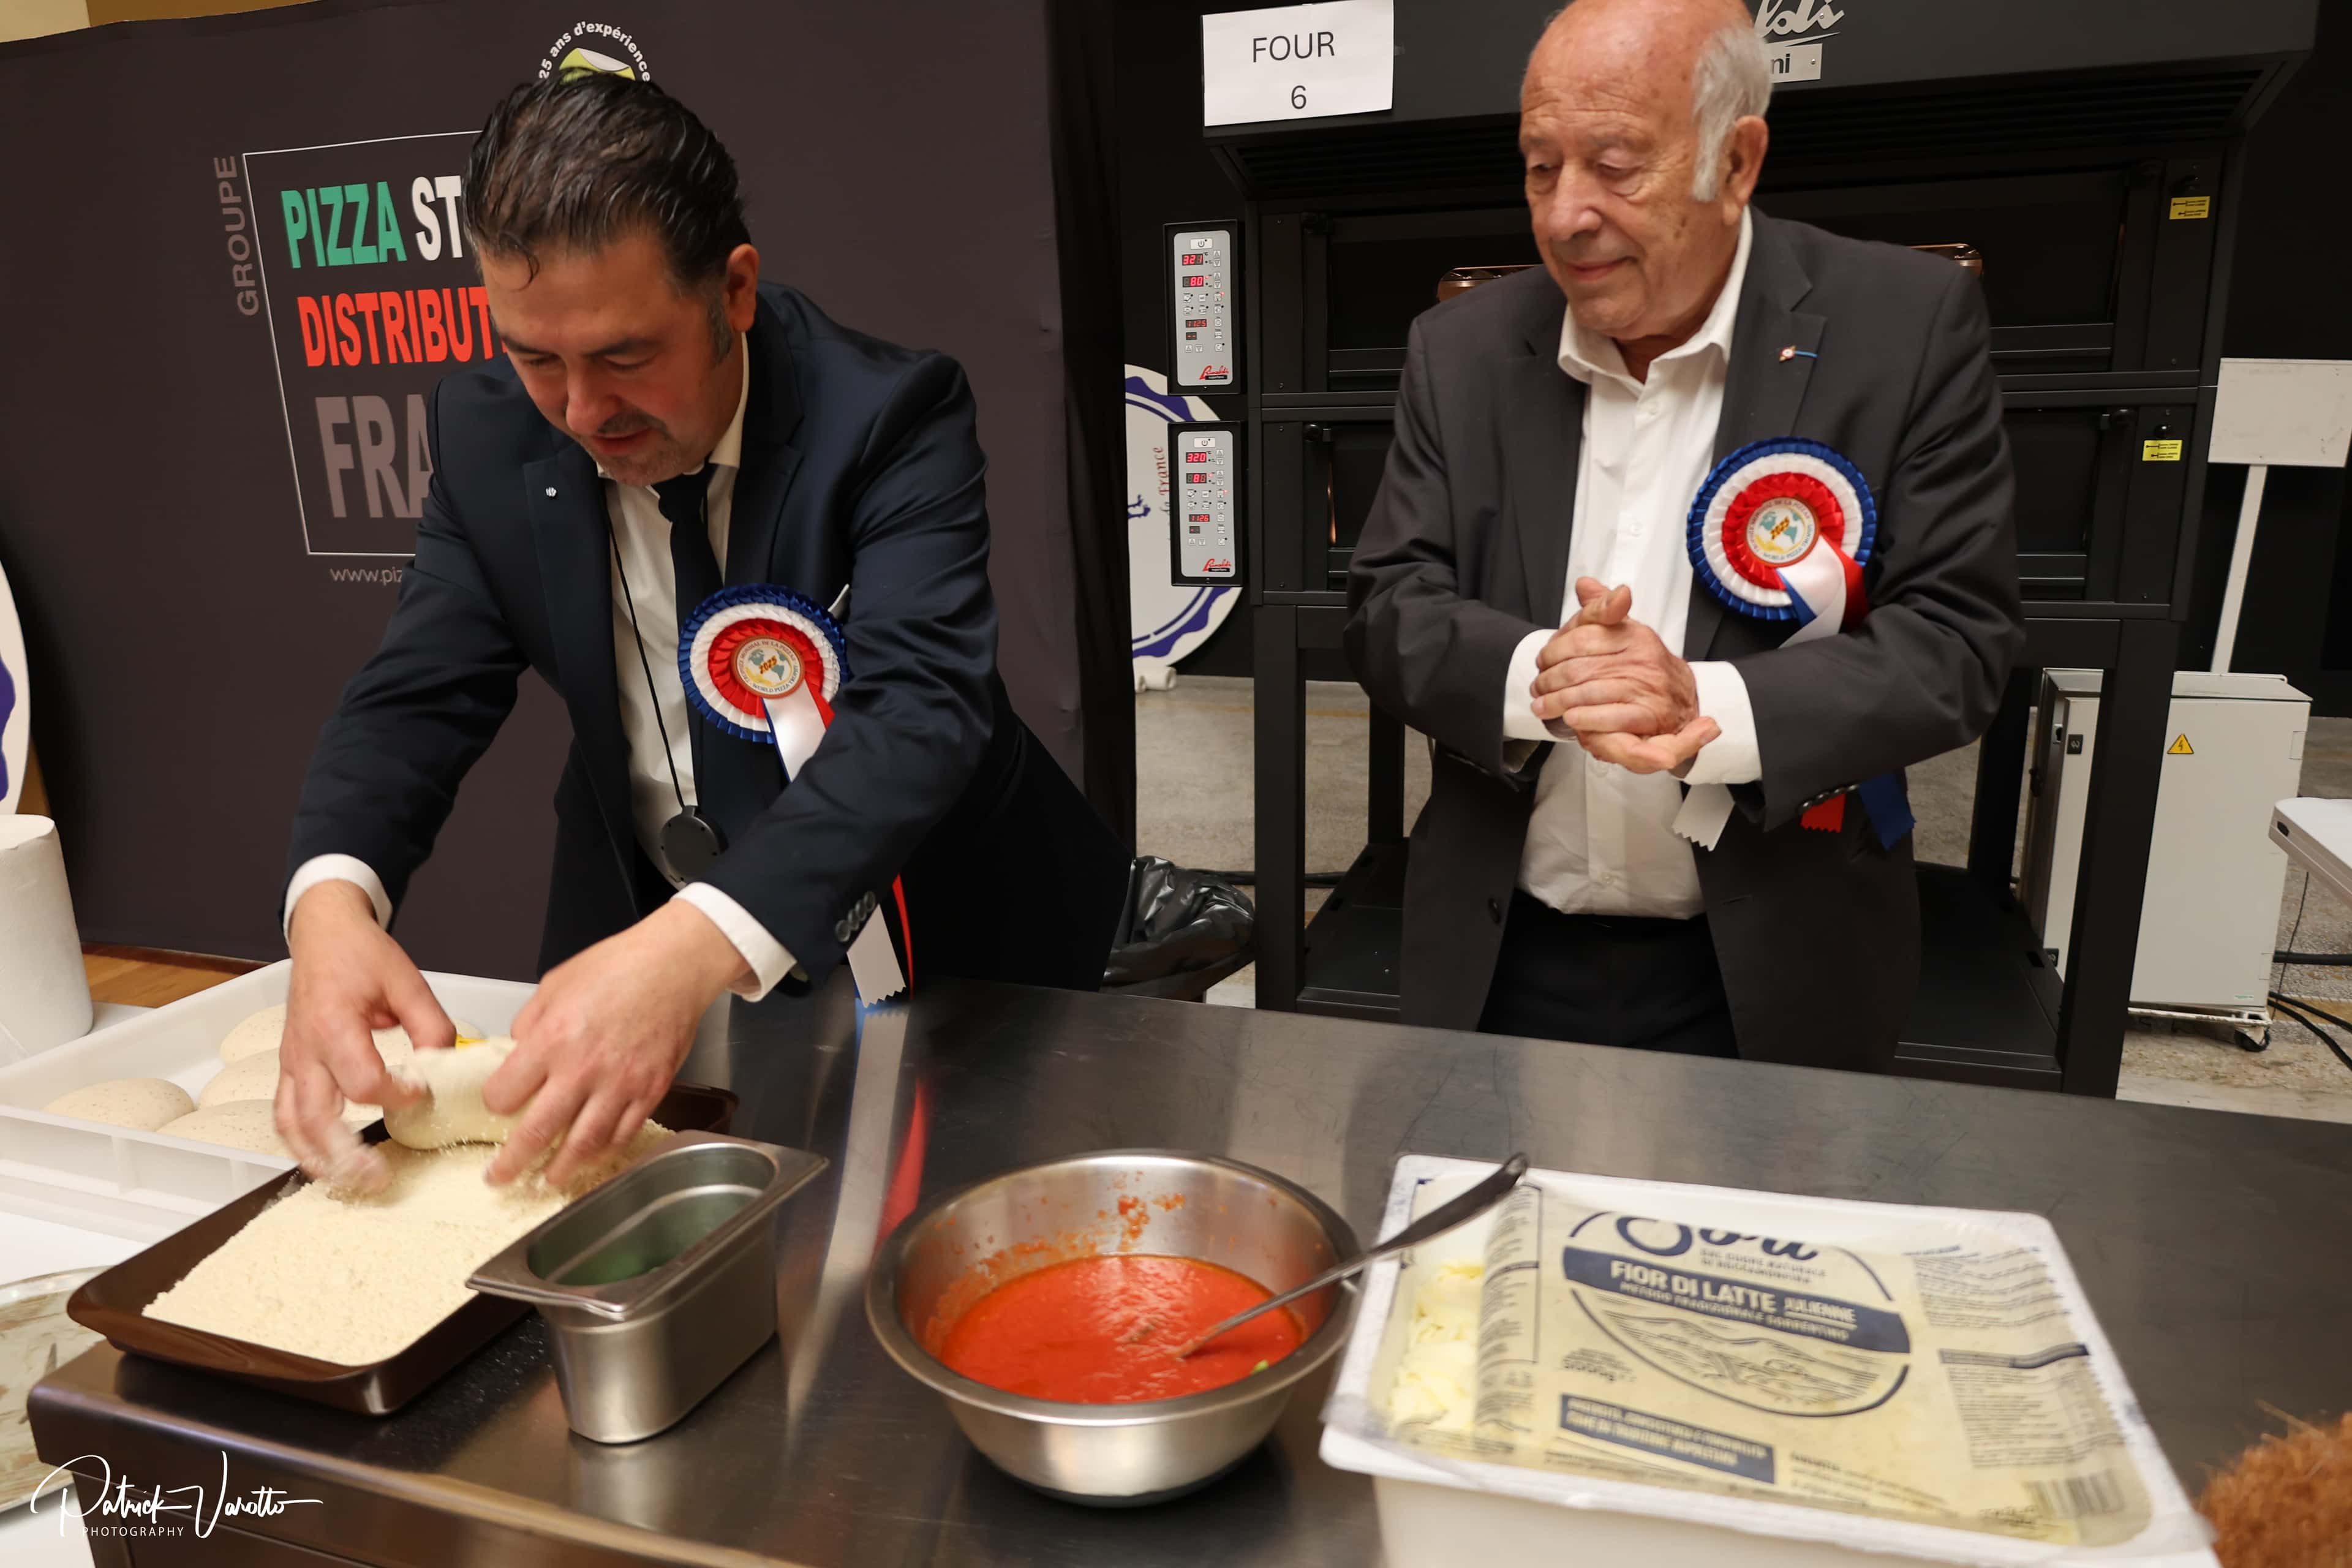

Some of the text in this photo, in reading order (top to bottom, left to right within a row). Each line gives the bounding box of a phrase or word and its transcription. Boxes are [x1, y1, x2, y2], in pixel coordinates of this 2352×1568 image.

[539, 21, 650, 81] 25 ans d'expérience
[1253, 31, 1335, 62] FOUR
[1291, 85, 1307, 110] 6
[214, 156, 259, 316] GROUPE
[281, 181, 407, 268] PIZZA
[1190, 276, 1204, 287] 80
[297, 287, 507, 367] DISTRIBUT
[1187, 453, 1206, 462] 320
[1610, 1260, 1668, 1290] FIOR
[1671, 1275, 1698, 1298] DI
[1702, 1280, 1777, 1314] LATTE
